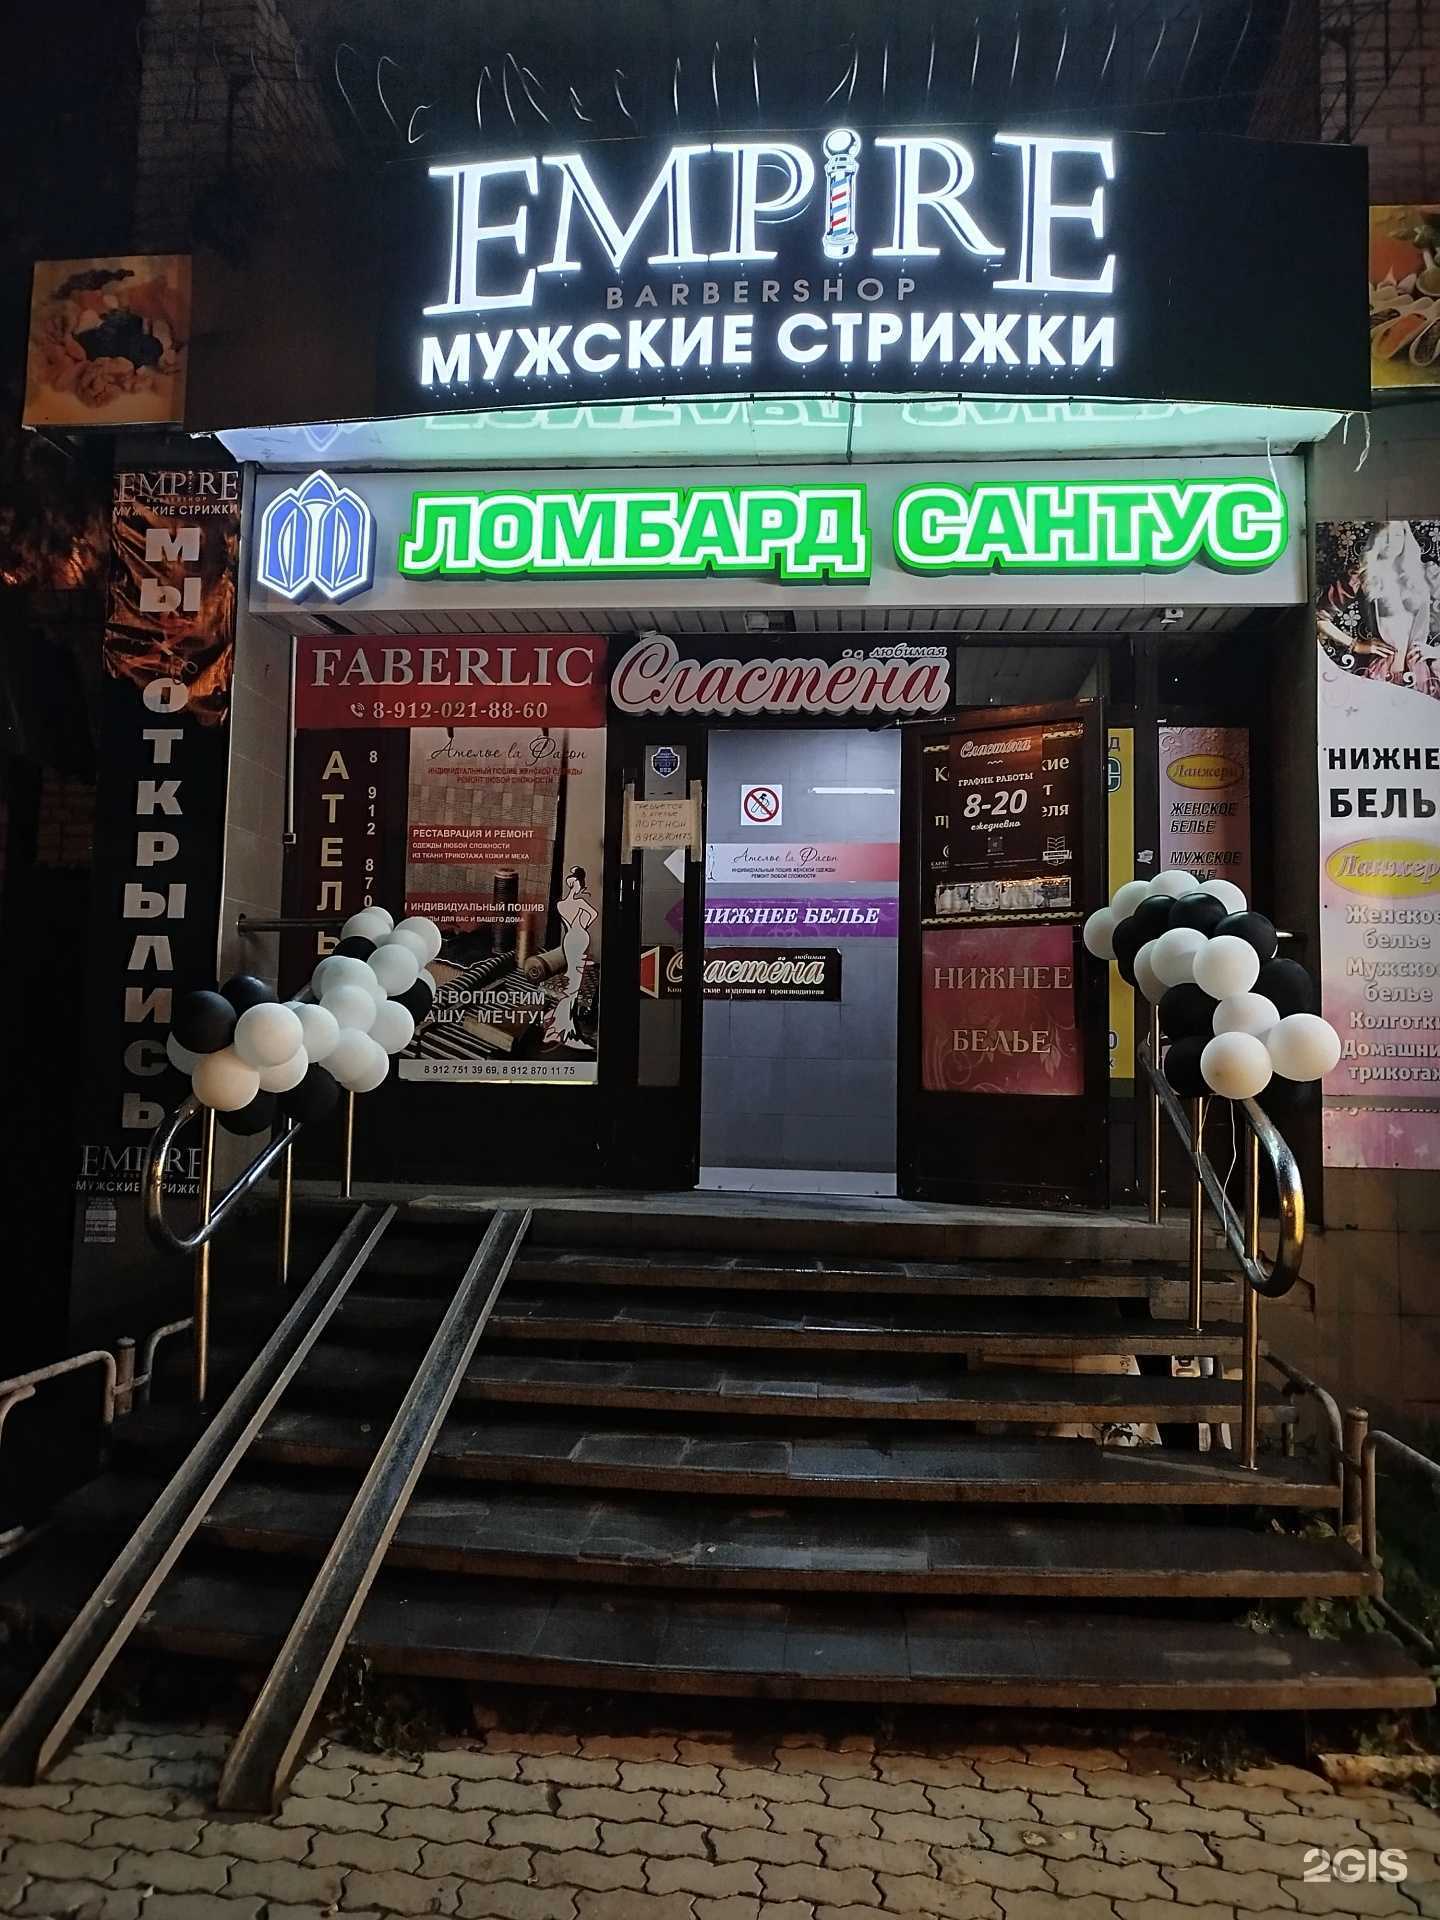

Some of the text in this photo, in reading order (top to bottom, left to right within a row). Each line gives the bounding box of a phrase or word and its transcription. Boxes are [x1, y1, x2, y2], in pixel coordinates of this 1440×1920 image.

[606, 276, 917, 311] BARBERSHOP
[420, 311, 1117, 386] МУЖСКИЕ СТРИЖКИ
[179, 503, 239, 516] СТРИЖКИ
[403, 480, 1286, 579] ЛОМБАРД САНТУС
[139, 527, 201, 613] МЫ
[868, 642, 948, 658] любимая
[310, 646, 595, 687] FABERLIC
[372, 701, 549, 719] 8-912-021-88-60
[369, 750, 378, 763] 8
[428, 737, 501, 762] Ателье
[958, 772, 1034, 787] ГРАФИК РАБОТЫ
[963, 789, 1028, 819] 8-20
[1169, 802, 1239, 816] ЖЕНСКОЕ
[412, 829, 534, 839] РЕСТАВРАЦИЯ И РЕМОНТ
[970, 820, 1021, 832] ежедневно
[1169, 820, 1217, 834] БЕЛЬЕ
[316, 750, 350, 956] АТЕЛЬ
[1169, 851, 1242, 865] МУЖСКОЕ
[122, 676, 187, 1129] ОТКРЫЛИСЬ
[410, 901, 545, 912] ИНДИВИДУАЛЬНЫЙ ПОШИВ
[802, 907, 880, 924] БЕЛЬЕ
[1363, 928, 1432, 949] белье
[666, 951, 825, 985] Састёна
[934, 966, 1073, 989] НИЖНЕЕ
[1345, 957, 1440, 982] Мужско
[448, 990, 545, 1005] ВОПЛОТИМ
[1364, 982, 1433, 1002] белье
[424, 1010, 545, 1026] АШУ МЕЧТУ!
[951, 1029, 1051, 1054] БЕЛЬЕ
[424, 1066, 430, 1074] 8
[432, 1066, 449, 1075] 912
[452, 1066, 468, 1075] 751
[472, 1066, 483, 1075] 39
[502, 1067, 508, 1075] 8
[511, 1067, 527, 1075] 912
[530, 1067, 547, 1075] 870
[551, 1067, 561, 1075] 11
[563, 1067, 575, 1075] 75
